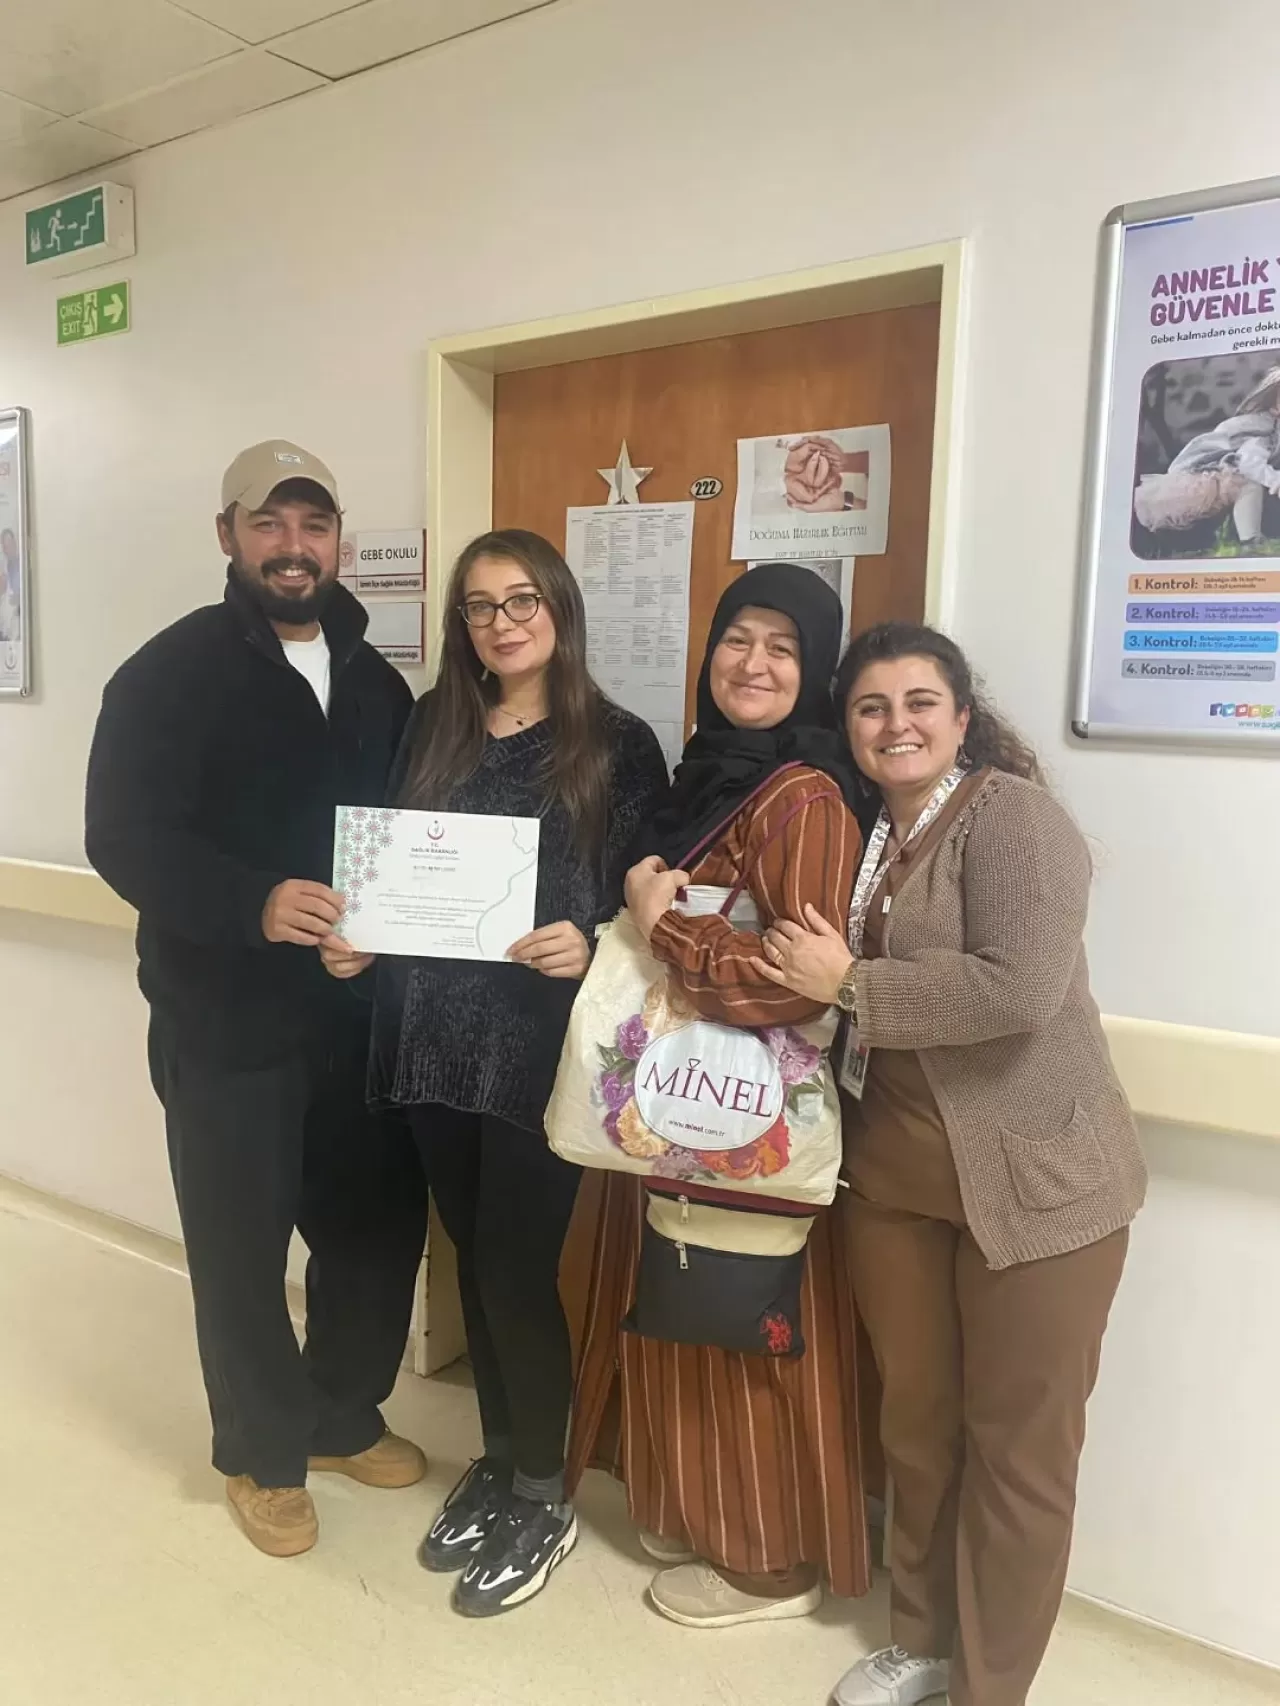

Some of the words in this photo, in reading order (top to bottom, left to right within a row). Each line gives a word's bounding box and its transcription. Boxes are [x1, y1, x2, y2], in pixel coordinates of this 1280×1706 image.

[1151, 256, 1269, 298] ANNELİK
[1150, 288, 1276, 327] GÜVENLE
[62, 320, 81, 336] EXIT
[1151, 335, 1175, 345] Gebe
[1177, 328, 1226, 341] kalmadan
[1228, 325, 1252, 335] önce
[1232, 336, 1268, 351] gerekli
[695, 480, 717, 496] 222
[360, 548, 384, 560] GEBE
[385, 546, 418, 560] OKULU
[1134, 578, 1142, 590] 1.
[1145, 577, 1198, 590] Kontrol:
[1131, 607, 1143, 619] 2.
[1146, 607, 1199, 619] Kontrol:
[1129, 635, 1140, 647] 3.
[1144, 635, 1197, 648] Kontrol:
[1126, 663, 1138, 674] 4.
[1141, 662, 1194, 676] Kontrol:
